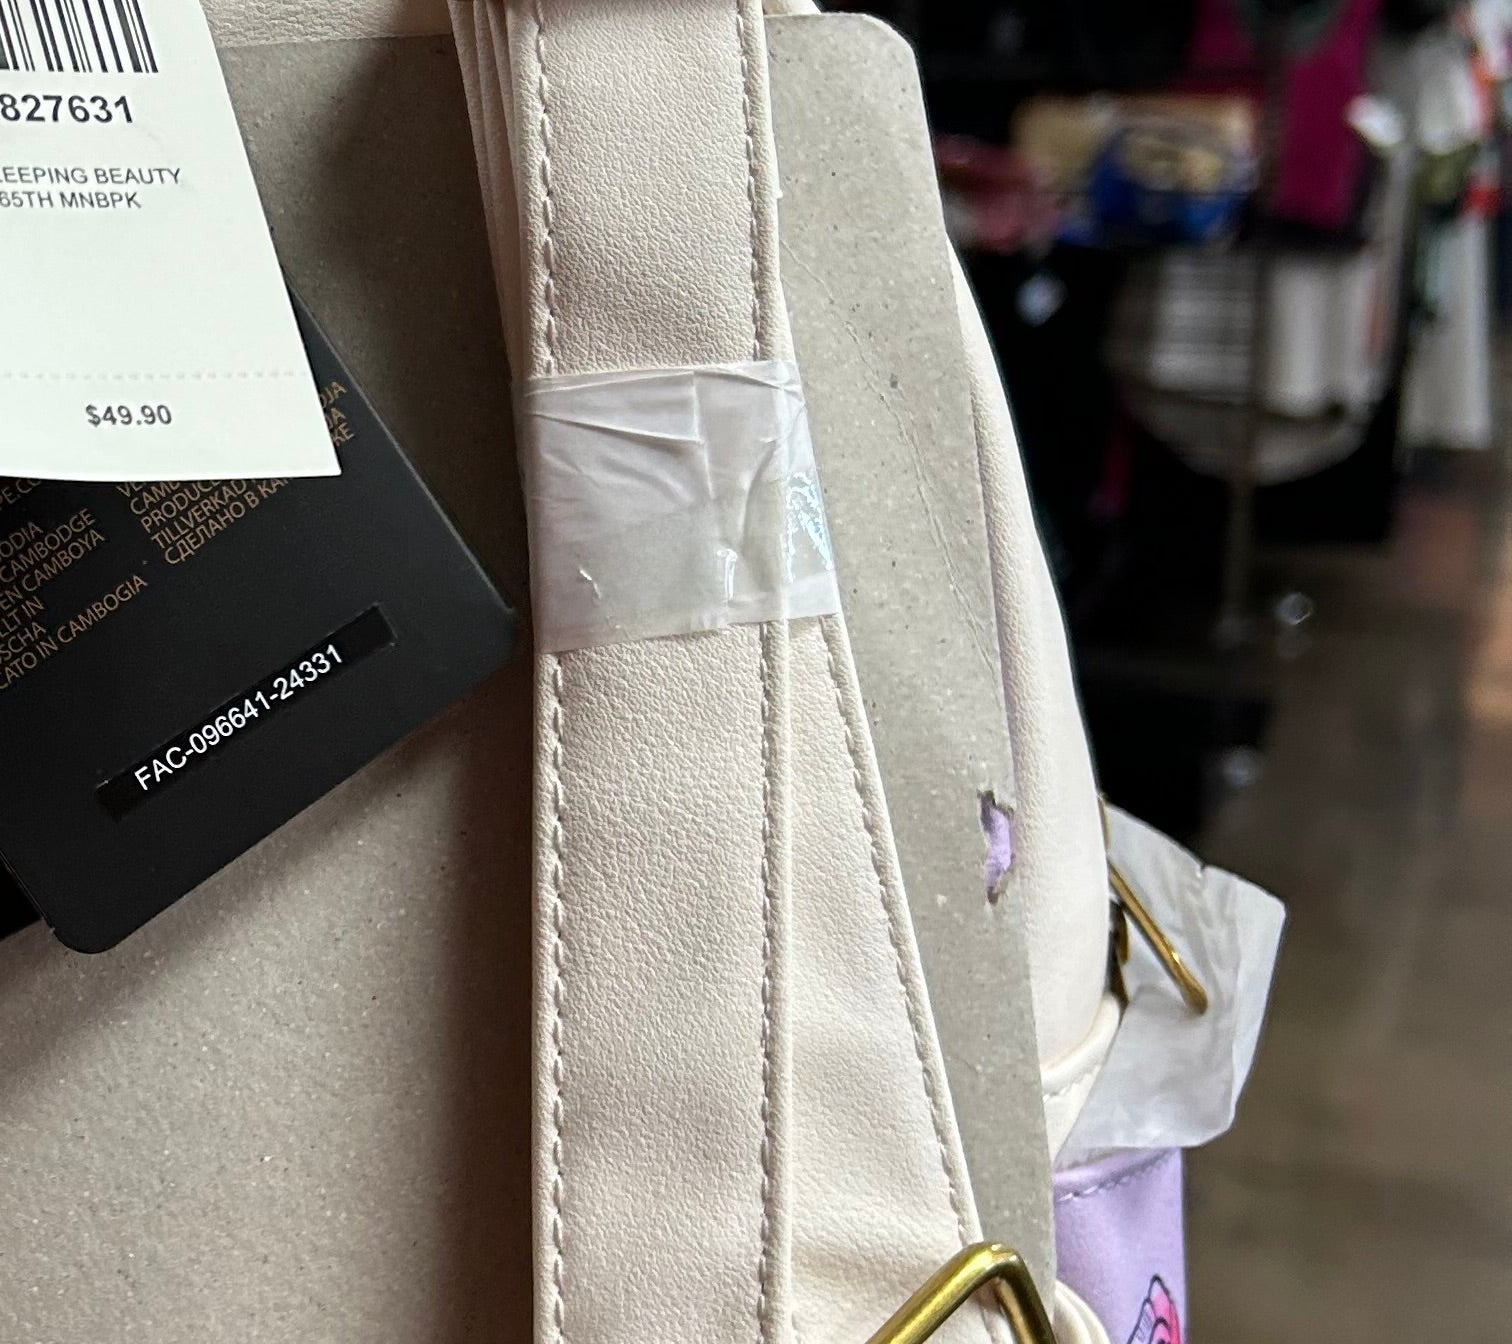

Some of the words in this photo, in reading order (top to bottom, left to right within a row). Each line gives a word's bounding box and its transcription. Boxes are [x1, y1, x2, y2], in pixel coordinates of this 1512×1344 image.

[94, 167, 182, 185] BEAUTY
[59, 191, 142, 209] MNBPK
[85, 404, 172, 428] $49.90
[162, 499, 249, 568] СДЕЛАНО
[19, 526, 105, 594] CAMBOYA
[21, 595, 44, 618] IN
[35, 636, 58, 658] IN
[54, 571, 148, 645] CAMBOGIA
[133, 643, 343, 790] FAC-096641-24331
